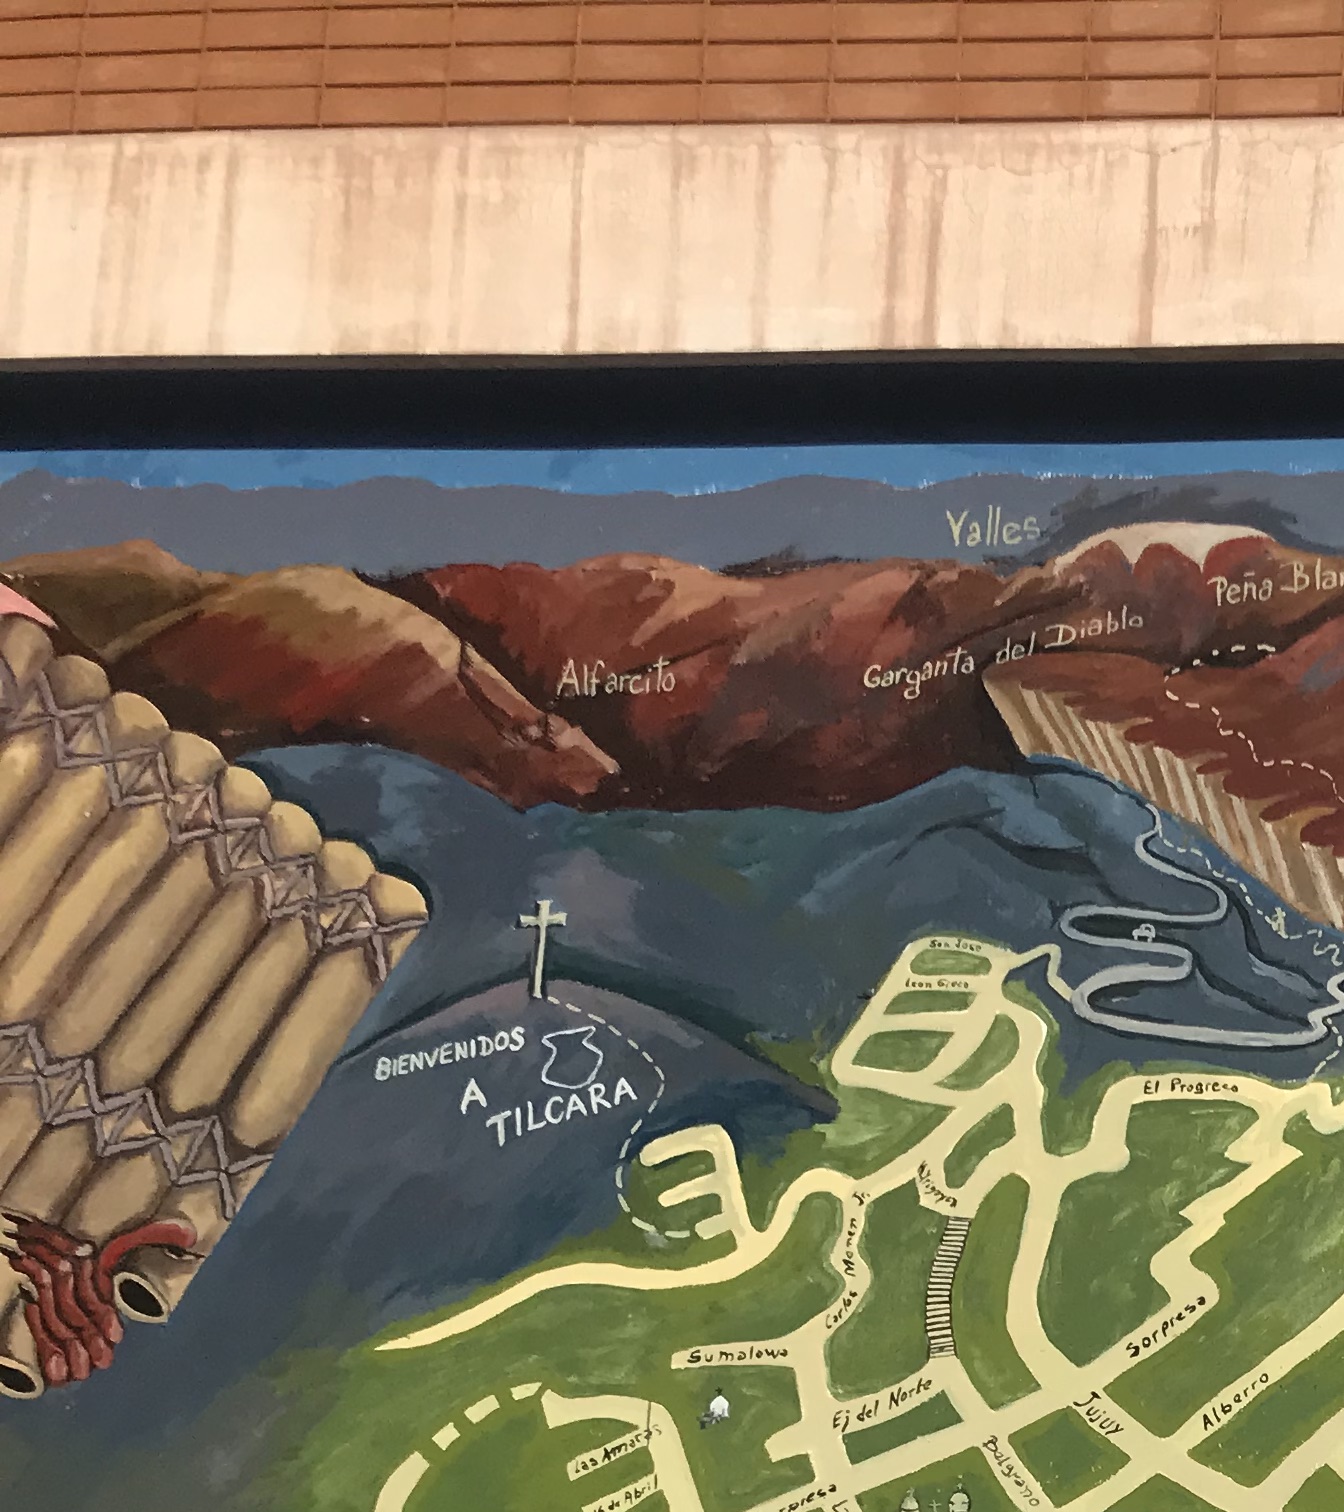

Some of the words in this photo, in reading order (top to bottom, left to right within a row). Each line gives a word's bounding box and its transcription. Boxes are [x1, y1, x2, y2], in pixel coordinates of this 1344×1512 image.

[946, 504, 1042, 548] Valles
[1207, 572, 1274, 608] Peña
[556, 655, 677, 698] Alfarcito
[863, 645, 976, 700] Garganta
[995, 632, 1036, 666] del
[1044, 605, 1144, 652] Diablo
[374, 1025, 526, 1082] BIENVENIDOS
[459, 1077, 488, 1115] A
[485, 1076, 639, 1147] TILCARA
[1142, 1079, 1159, 1096] El
[1126, 1295, 1207, 1359] Sorpresa
[855, 1400, 880, 1423] del
[888, 1374, 933, 1411] Norte
[1073, 1389, 1125, 1437] Jujuy
[1200, 1371, 1270, 1432] Alberro
[625, 1473, 658, 1505] Abril
[982, 1433, 1041, 1508] Belgrano
